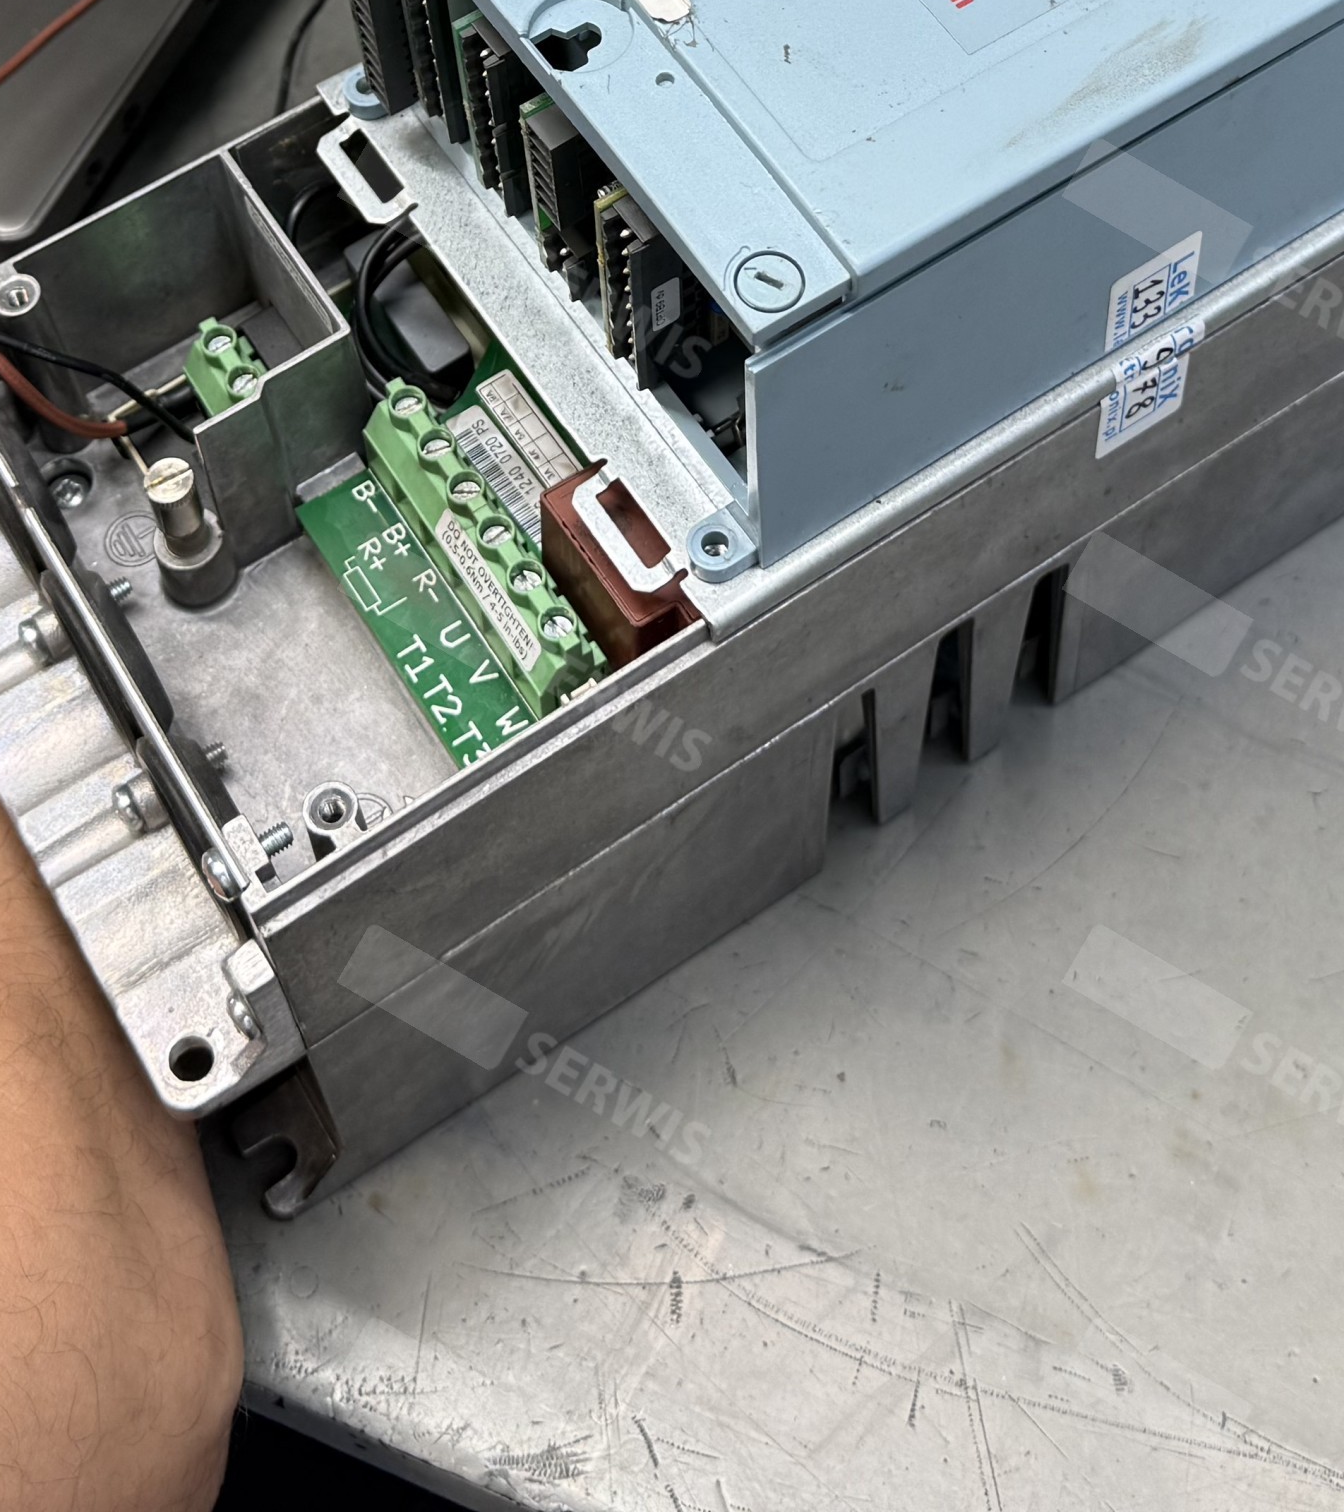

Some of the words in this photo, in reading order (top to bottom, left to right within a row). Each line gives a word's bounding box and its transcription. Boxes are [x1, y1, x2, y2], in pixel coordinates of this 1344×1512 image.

[471, 418, 489, 436] PS
[485, 436, 513, 464] 0720
[508, 465, 537, 495] 1240
[356, 535, 388, 573] R+
[447, 520, 462, 539] DO
[460, 540, 479, 565] NOT
[477, 566, 534, 650] OVERTIGHTEN!
[351, 478, 379, 514] B-
[381, 521, 412, 557] B+
[412, 567, 440, 604] R-
[438, 619, 473, 649] U
[468, 658, 500, 685] V
[494, 704, 530, 737] W
[489, 601, 504, 623] 4-5
[396, 632, 437, 685] T1
[452, 720, 494, 767] T3
